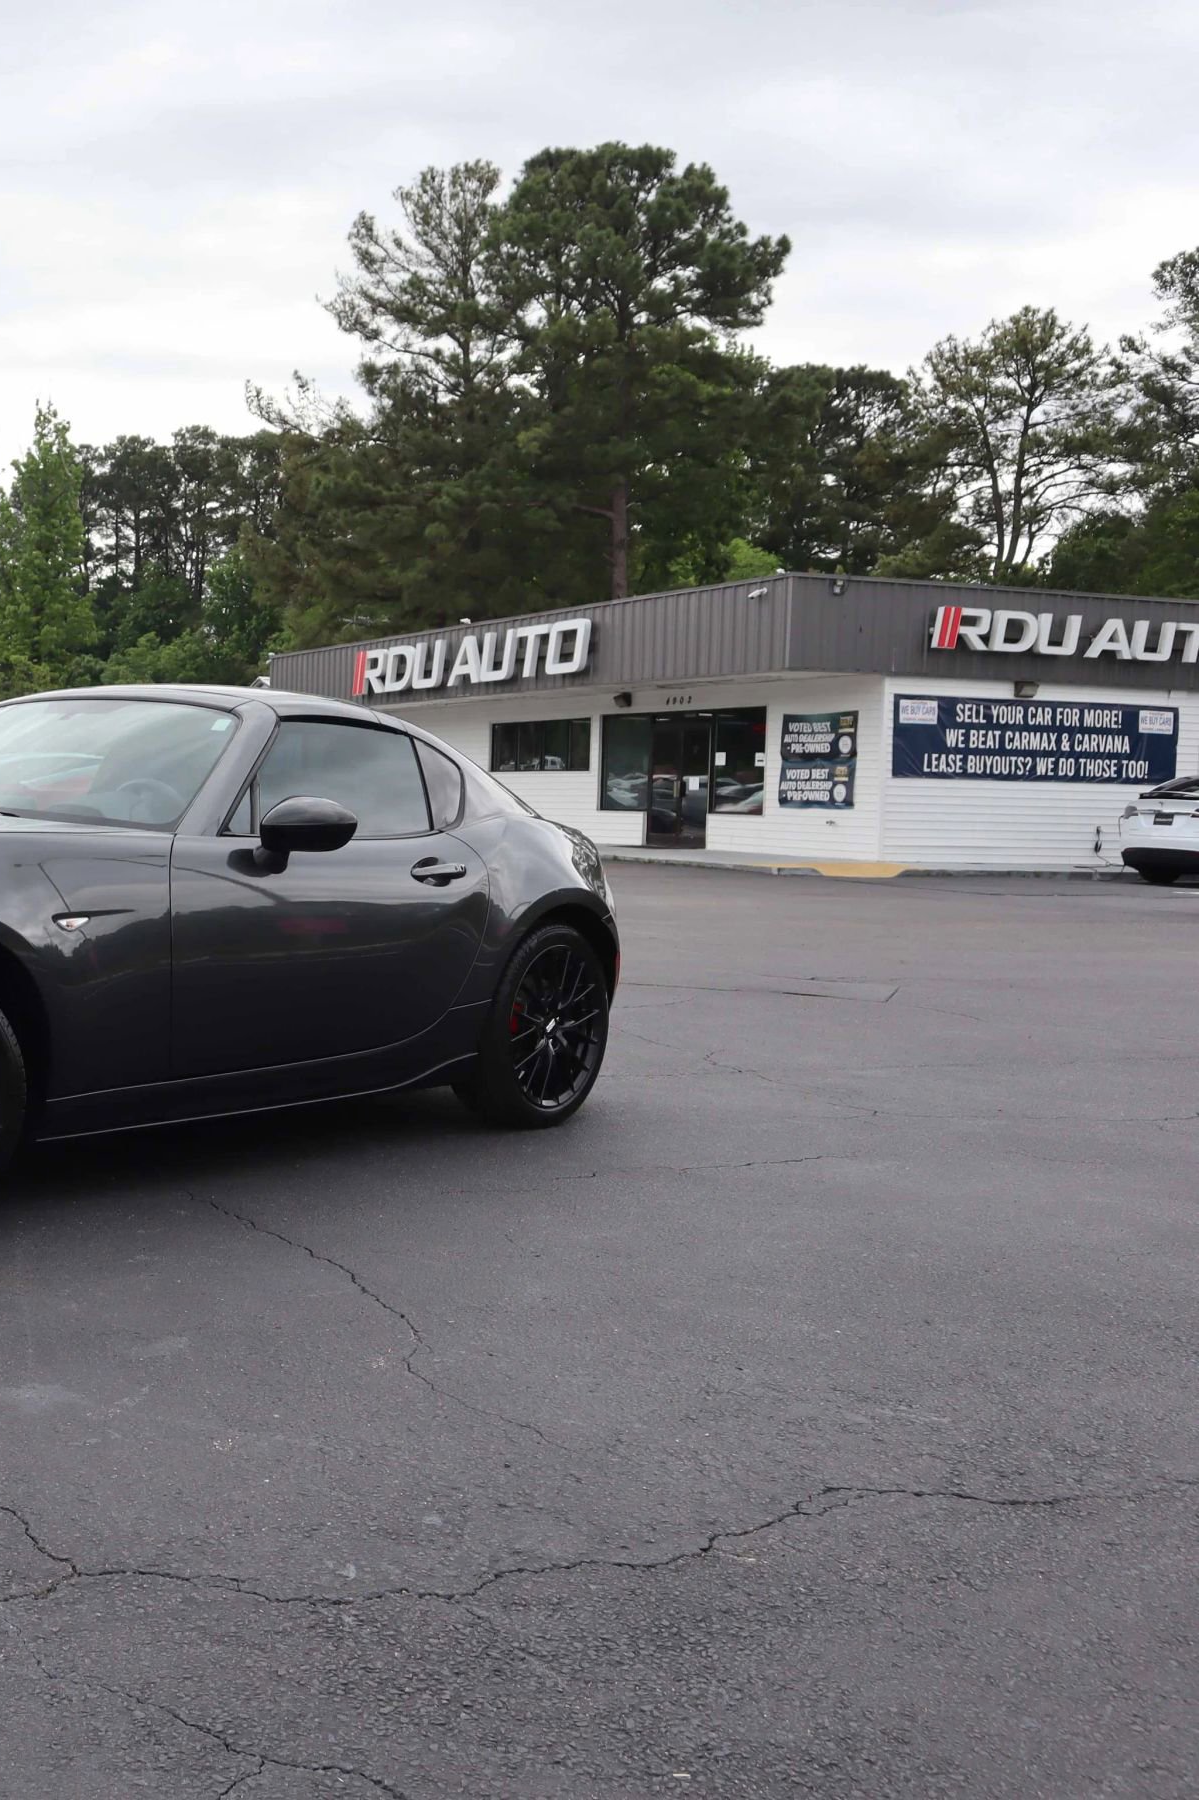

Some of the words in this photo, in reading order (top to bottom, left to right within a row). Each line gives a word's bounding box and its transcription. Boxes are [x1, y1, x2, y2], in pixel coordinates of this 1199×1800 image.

[956, 606, 1082, 656] RDU
[363, 638, 447, 694] RDU
[447, 617, 592, 688] AUTO
[788, 722, 812, 732] VOTED
[813, 721, 831, 732] BEST
[956, 703, 987, 723] SELL
[991, 704, 1024, 725] YOUR
[1028, 706, 1052, 726] CAR
[1056, 707, 1080, 727] FOR
[1083, 708, 1122, 729] MORE!
[784, 734, 799, 743] AUTO
[799, 733, 835, 743] DEALERSHIP
[946, 728, 966, 748] WE
[969, 729, 1001, 749] BEAT
[1005, 731, 1058, 751] CARMAX
[1061, 733, 1070, 751] &
[1074, 733, 1130, 753] CARVANA
[786, 768, 810, 780] VOTED
[811, 768, 829, 779] BEST
[923, 753, 963, 773] LEASE
[967, 755, 1032, 775] BUYOUTS?
[1036, 757, 1055, 776] WE
[1058, 758, 1075, 776] DO
[1079, 758, 1118, 778] THOSE
[1122, 760, 1149, 779] TOO!
[780, 781, 796, 790] AUTO
[797, 781, 833, 790] DEALERSHIP
